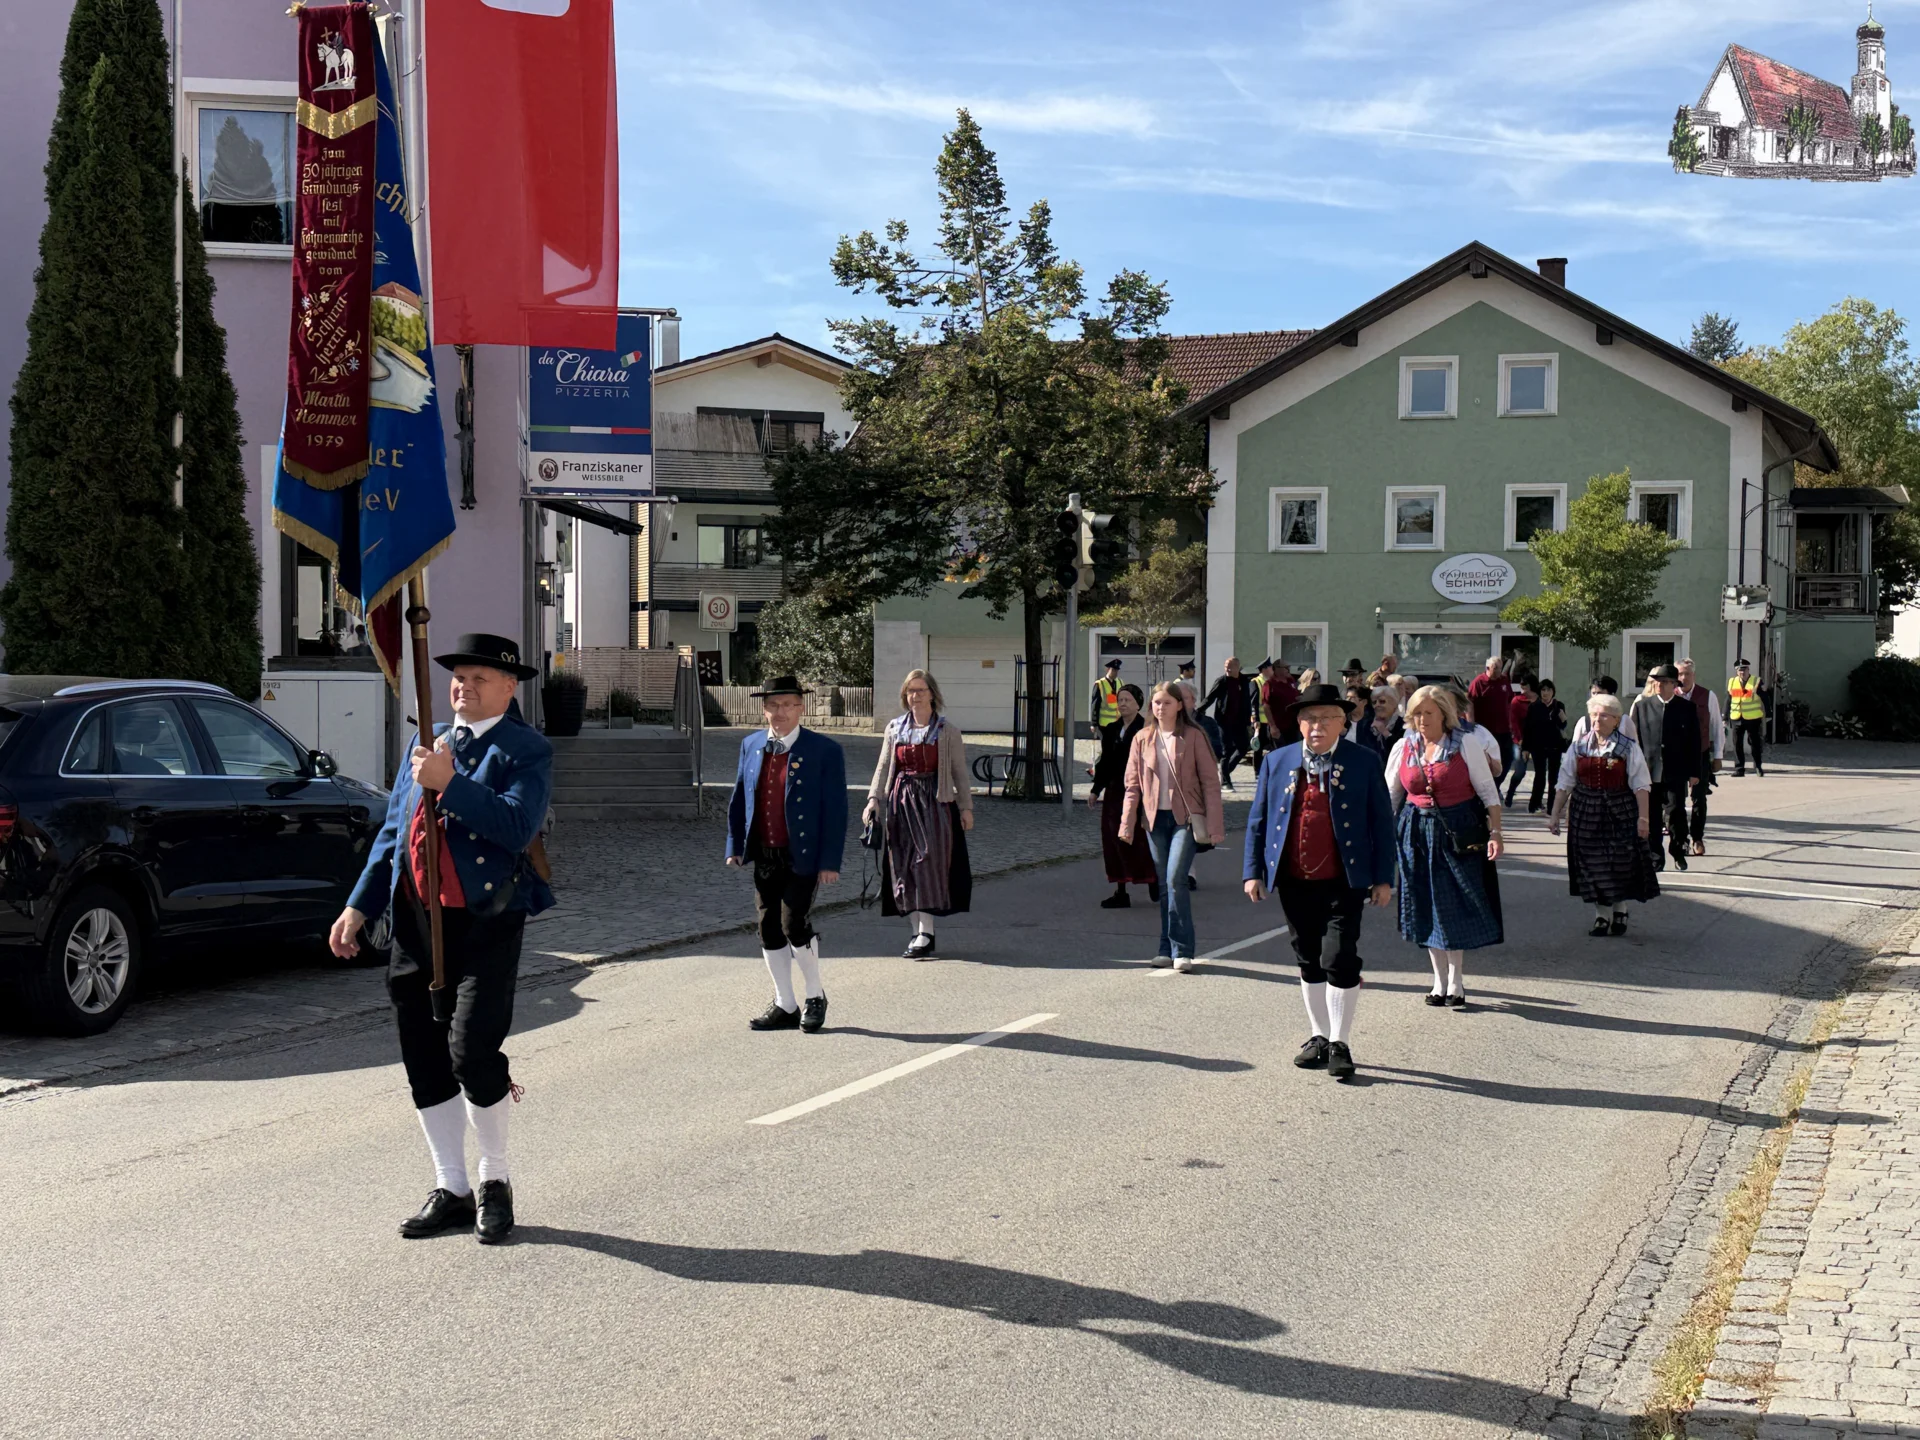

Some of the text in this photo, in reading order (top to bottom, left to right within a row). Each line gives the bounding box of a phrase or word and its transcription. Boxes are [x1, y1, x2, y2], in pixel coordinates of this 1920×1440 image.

[302, 162, 320, 179] 50
[305, 246, 358, 267] gewidmet
[319, 266, 343, 276] vom
[538, 349, 630, 385] da Chiara
[303, 389, 351, 408] Martin
[555, 387, 630, 399] PIZZERIA
[306, 434, 344, 448] 1979
[562, 460, 643, 474] Franziskaner
[581, 474, 624, 483] WEISSBIER
[1442, 570, 1509, 579] FAHRSCHULE
[1445, 579, 1505, 588] SCHMIDT
[712, 602, 726, 614] 30
[710, 620, 728, 628] ZONE
